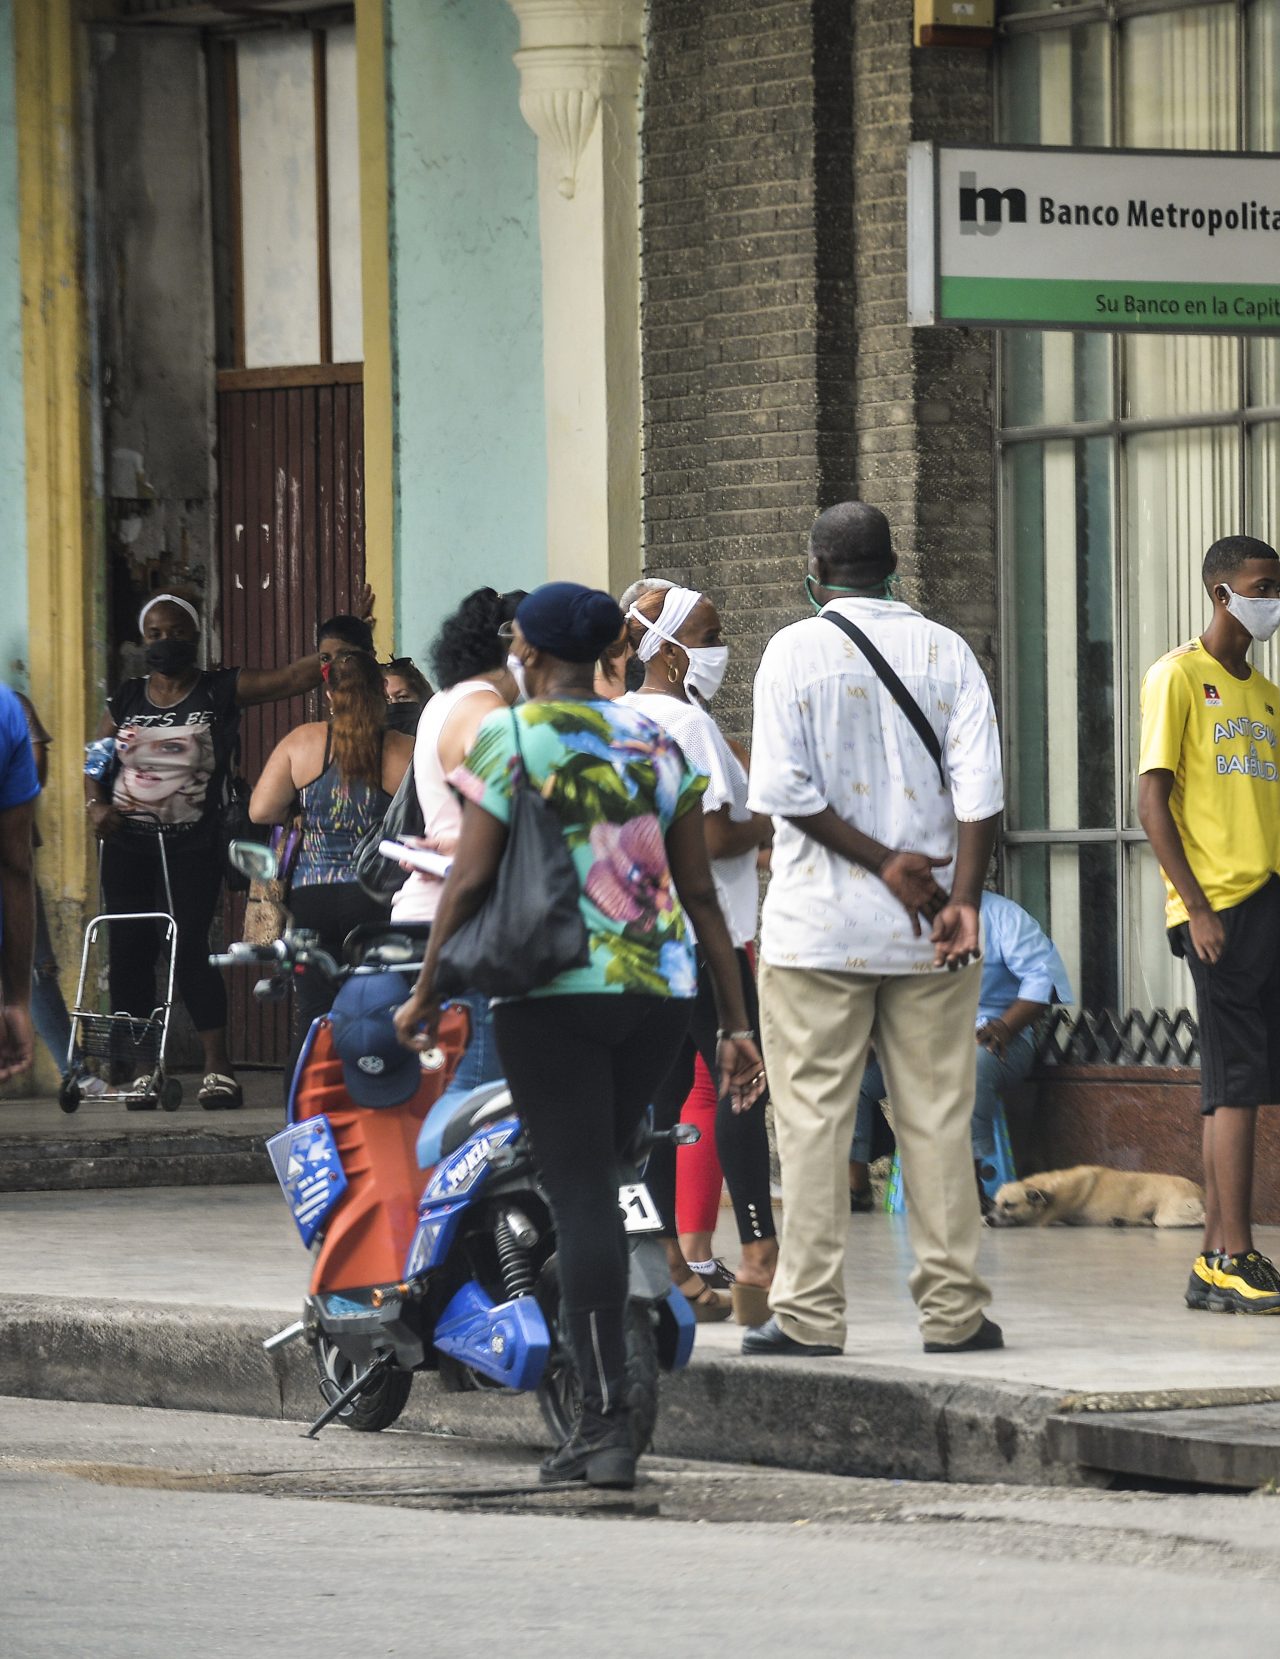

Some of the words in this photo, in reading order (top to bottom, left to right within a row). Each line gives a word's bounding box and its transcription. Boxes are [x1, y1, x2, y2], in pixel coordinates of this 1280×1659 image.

[1039, 197, 1120, 227] Banco
[1095, 294, 1119, 313] Su
[1124, 295, 1180, 314] Banco
[1184, 300, 1207, 314] en
[1212, 296, 1228, 316] la
